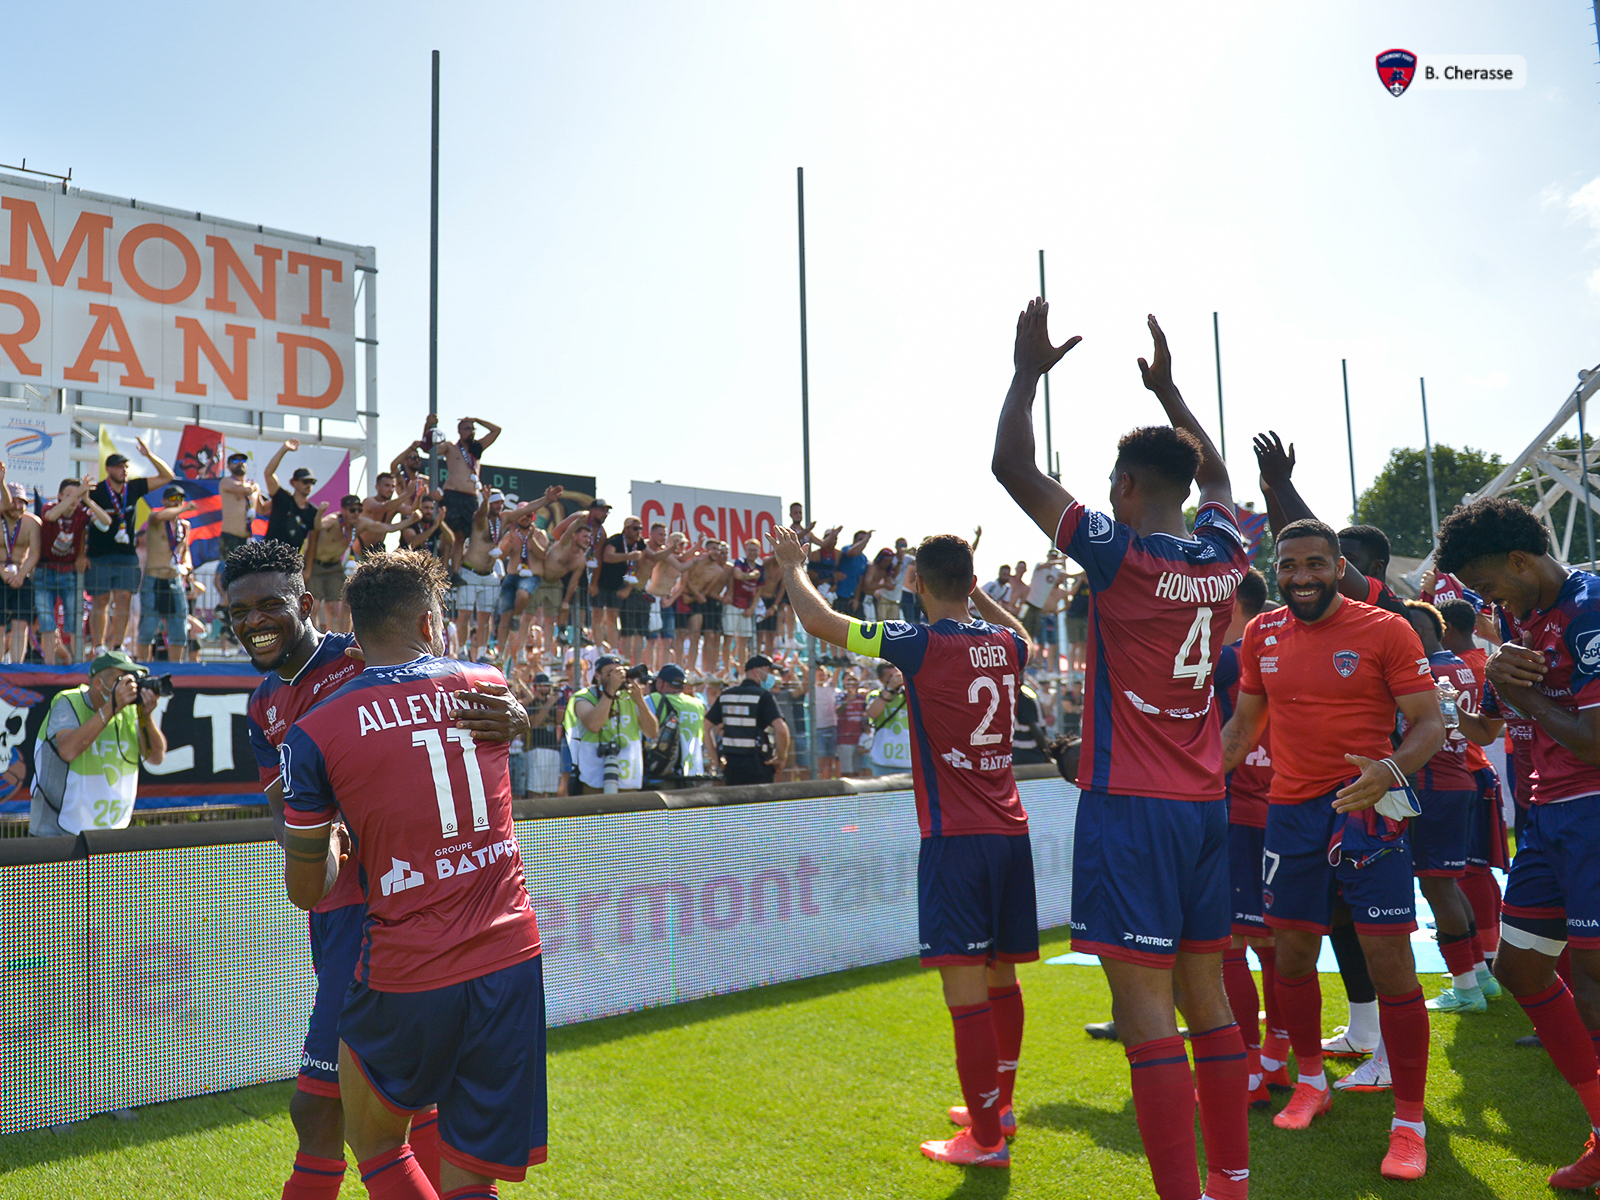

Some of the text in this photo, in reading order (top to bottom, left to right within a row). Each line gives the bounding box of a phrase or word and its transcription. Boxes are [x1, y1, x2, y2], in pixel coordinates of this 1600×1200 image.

[493, 474, 518, 490] DE
[640, 499, 777, 562] CASINO
[1172, 606, 1213, 690] 4
[968, 673, 1016, 746] 21
[411, 727, 491, 839] 11
[434, 841, 473, 857] GROUPE
[1135, 934, 1174, 947] PATRICK
